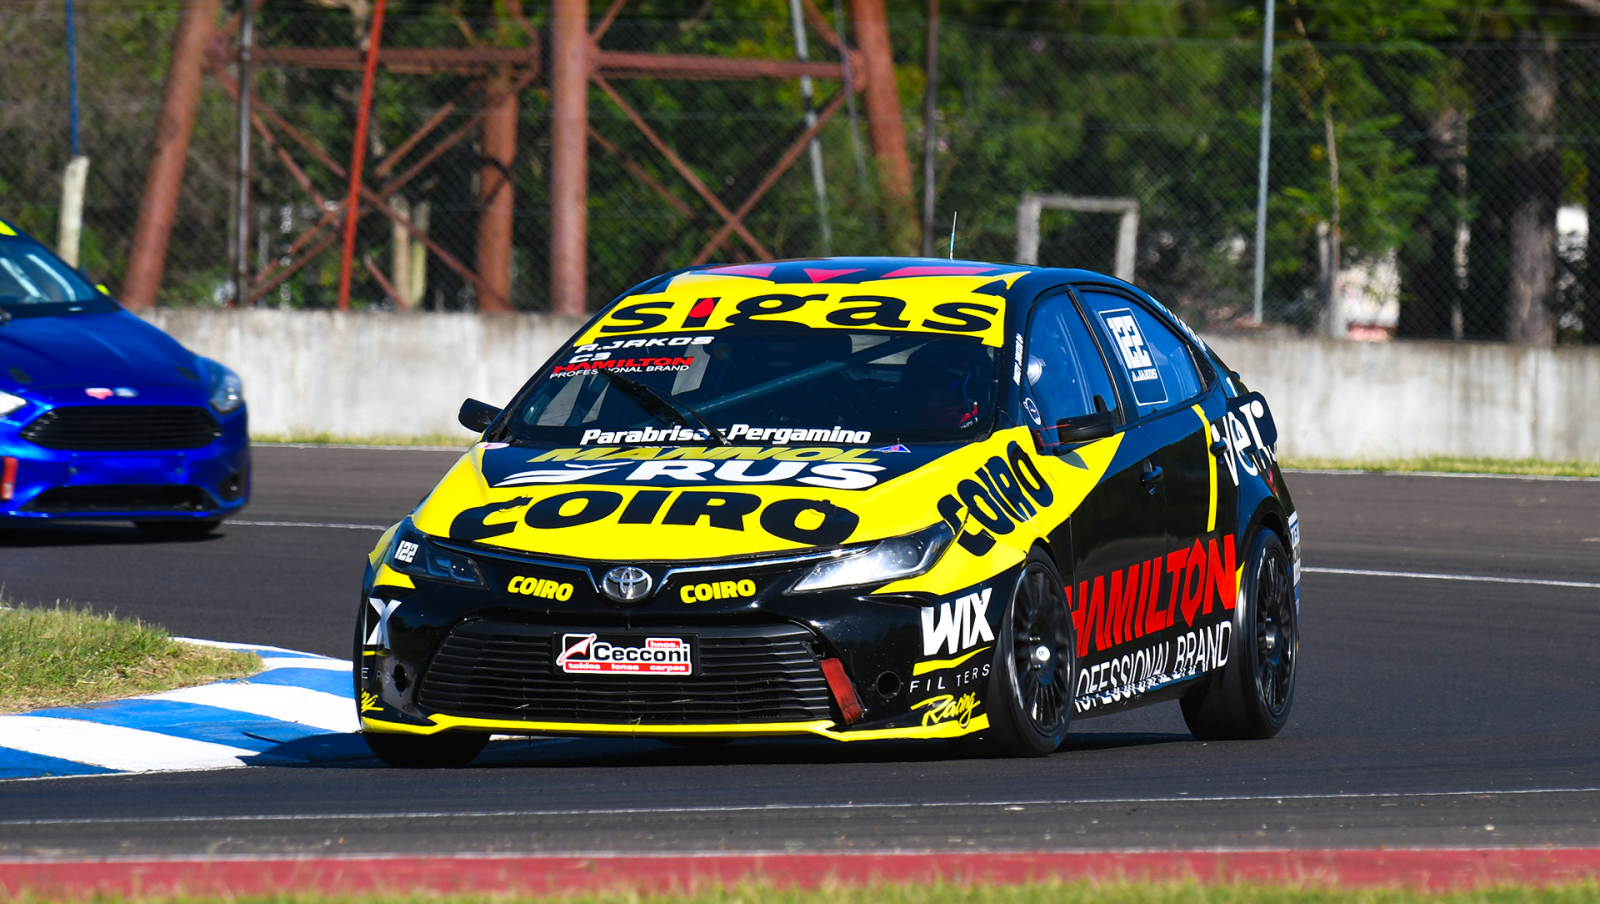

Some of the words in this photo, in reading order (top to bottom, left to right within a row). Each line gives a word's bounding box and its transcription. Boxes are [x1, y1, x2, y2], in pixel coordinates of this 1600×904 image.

[600, 292, 999, 332] sigas
[575, 336, 715, 353] A.JAKOS
[1106, 315, 1152, 369] 122
[552, 357, 694, 374] HAMILTON
[568, 352, 611, 364] C3
[646, 364, 690, 372] BRAND
[727, 424, 871, 445] Pergamino
[527, 446, 879, 463] MANNOL
[625, 460, 887, 490] RUS
[937, 440, 1054, 557] COIRO
[450, 490, 860, 546] COIRO
[395, 540, 419, 563] 122
[507, 576, 574, 602] COIRO
[680, 579, 756, 604] COIRO
[1064, 534, 1237, 658] HAMILTON
[921, 587, 995, 656] WIX
[594, 644, 688, 662] Cecconi
[1173, 620, 1232, 680] BRAND
[650, 664, 686, 672] carpas
[910, 692, 981, 729] Racing
